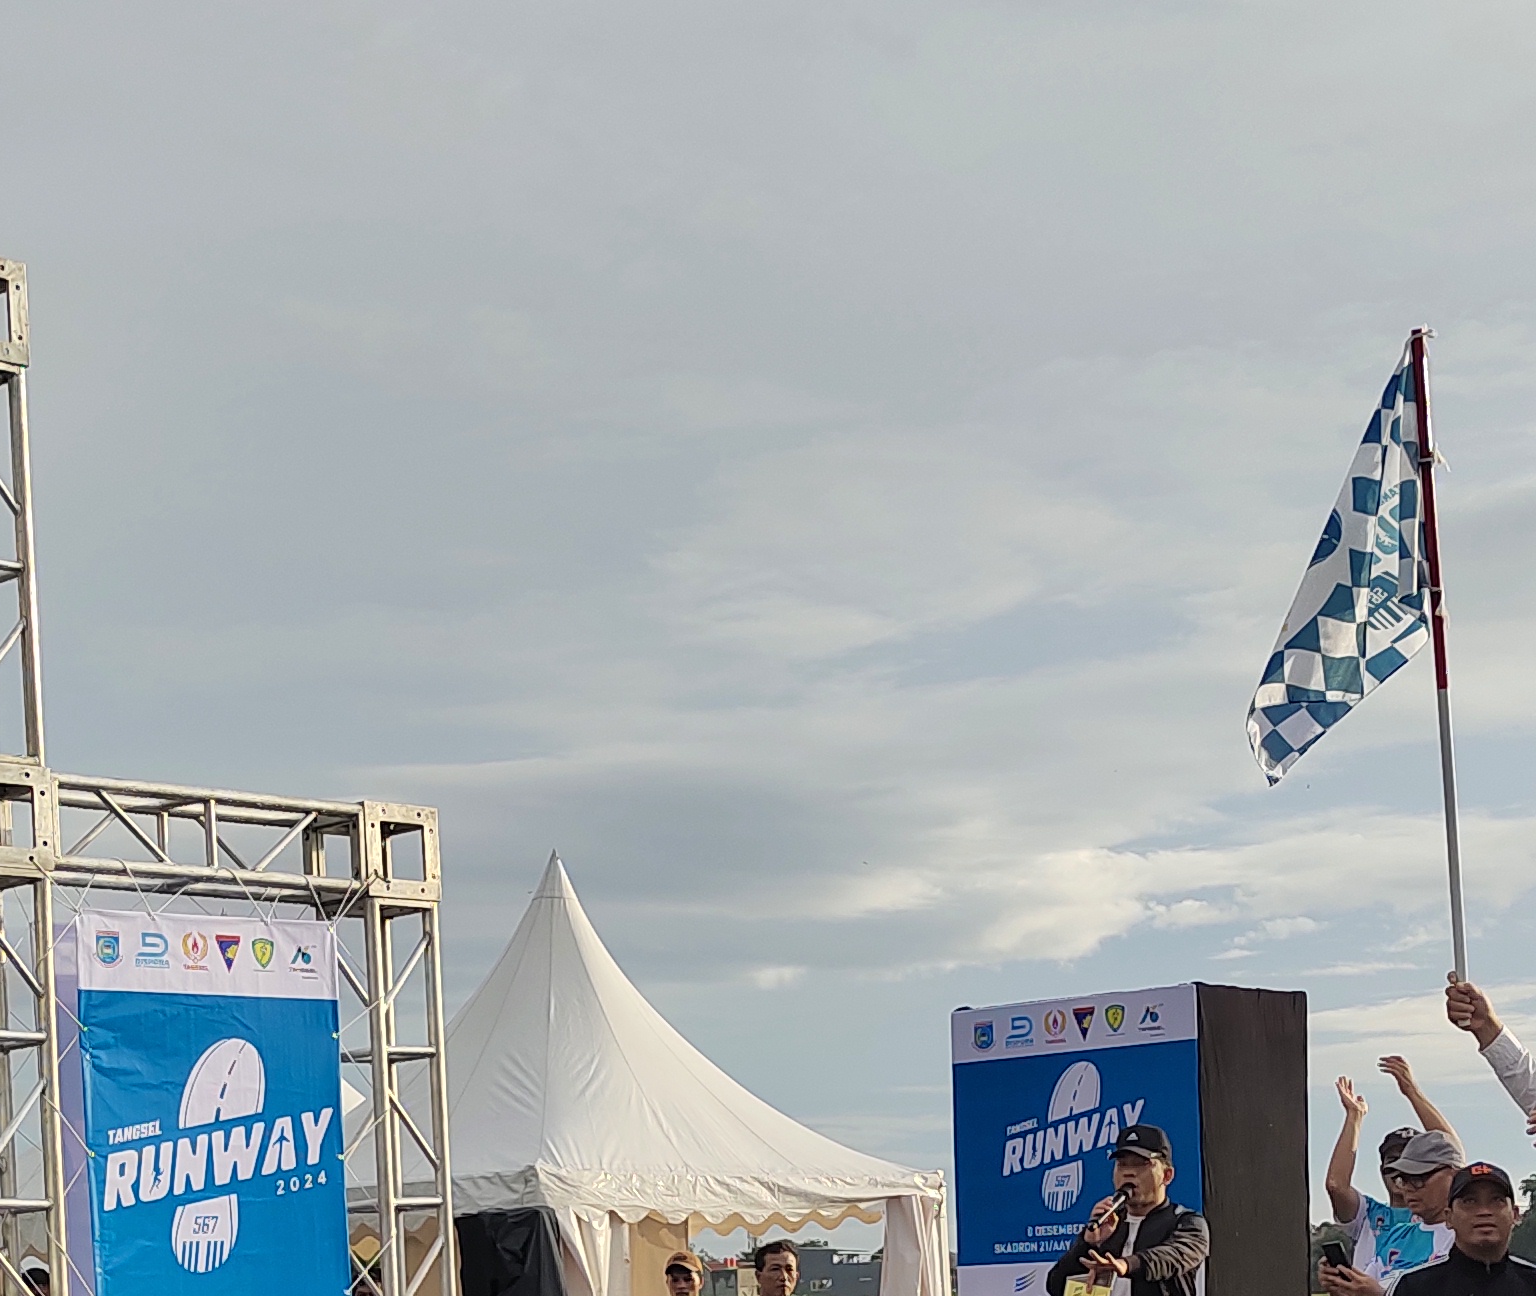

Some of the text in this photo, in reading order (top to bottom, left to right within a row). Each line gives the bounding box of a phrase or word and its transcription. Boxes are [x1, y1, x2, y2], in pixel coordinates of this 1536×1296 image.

[107, 1119, 162, 1145] TANGSEL
[1002, 1098, 1145, 1177] RUNWAY
[103, 1106, 334, 1213] RUNWAY
[275, 1170, 327, 1195] 2024
[192, 1216, 219, 1235] 567
